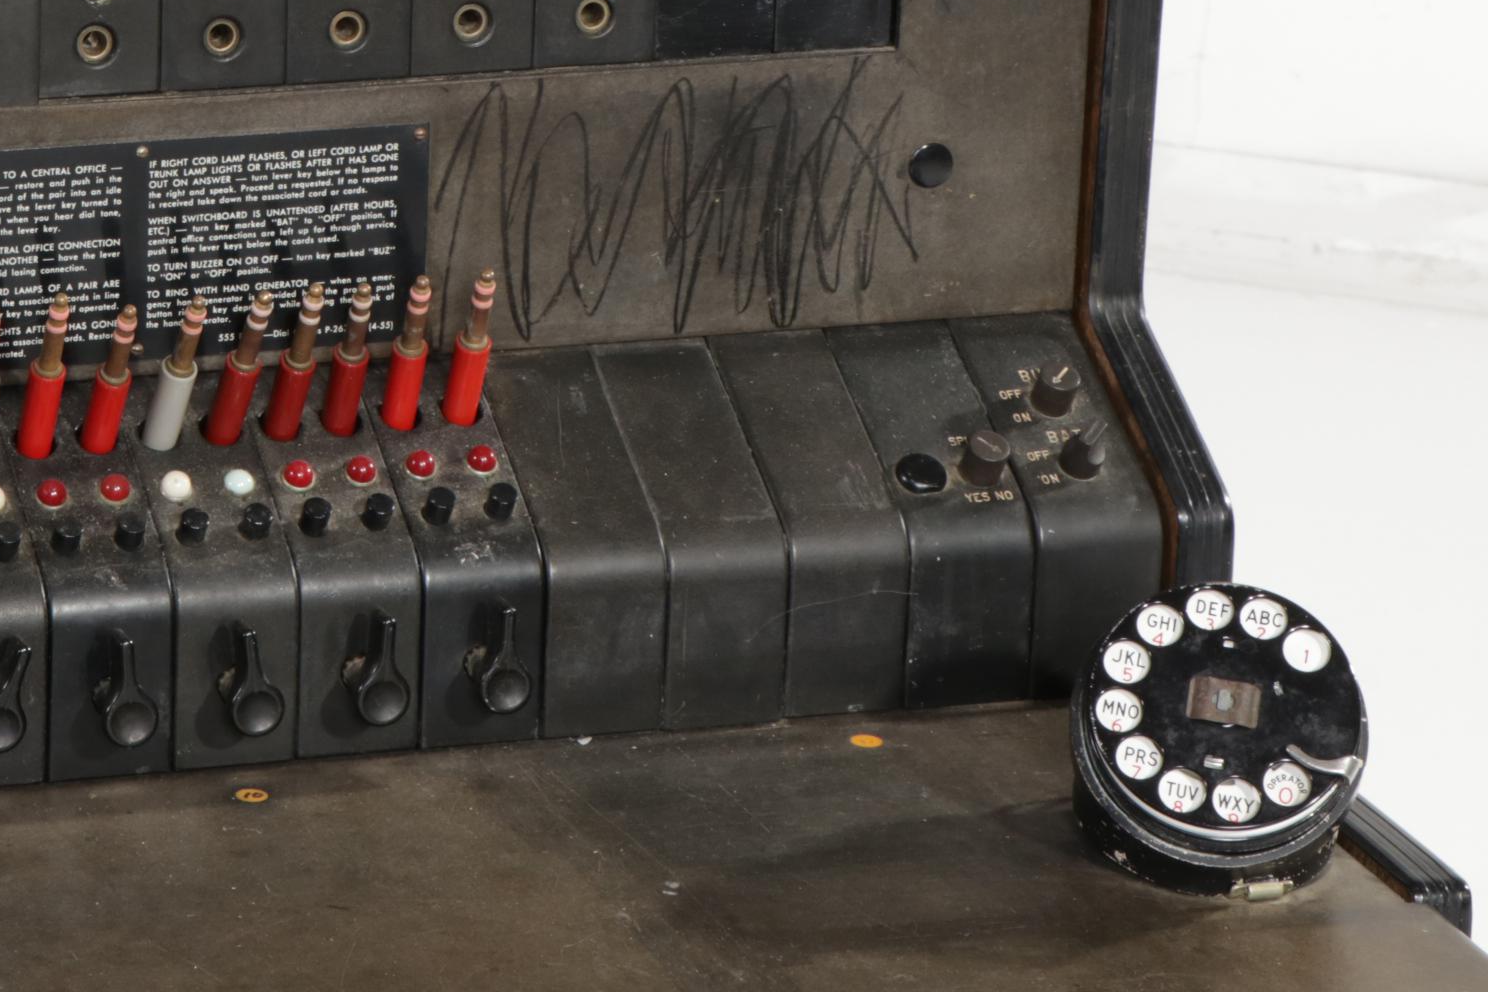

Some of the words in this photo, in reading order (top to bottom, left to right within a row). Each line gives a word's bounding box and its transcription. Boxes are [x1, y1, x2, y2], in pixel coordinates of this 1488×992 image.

[149, 160, 157, 168] IF
[160, 157, 188, 168] RIGHT
[191, 156, 218, 166] CORD
[221, 154, 245, 163] LAMP
[248, 151, 287, 161] FLASHES,
[290, 149, 304, 158] OR
[308, 147, 327, 157] LEFT
[330, 146, 356, 156] CORD
[359, 144, 382, 153] LAMP
[385, 142, 398, 151] OR
[2, 170, 16, 179] TO
[20, 170, 27, 178] A
[31, 167, 70, 177] CENTRAL
[74, 163, 106, 174] OFFICE
[147, 216, 176, 224] WHEN
[181, 210, 247, 223] SWITCHBOARD
[252, 209, 261, 218] IS
[266, 204, 325, 217] UNATTENDED
[330, 202, 358, 213] (AFTER
[363, 199, 396, 209] HOURS,
[22, 242, 54, 253] OFFICE
[57, 238, 120, 250] CONNECTION
[147, 263, 160, 272] TO
[163, 261, 187, 271] TURN
[190, 258, 223, 269] BUZZER
[226, 257, 242, 266] ON
[244, 256, 258, 265] OR
[260, 254, 278, 264] OFF
[14, 284, 43, 295] LAMPS
[47, 283, 60, 292] OF
[66, 283, 72, 291] A
[77, 280, 97, 289] PAIR
[102, 279, 119, 288] ARE
[998, 389, 1023, 400] OFF
[1013, 412, 1032, 423] ON
[1026, 449, 1049, 461] OFF
[1041, 473, 1061, 485] ON
[964, 492, 991, 503] YES
[995, 491, 1014, 501] NO
[1195, 599, 1230, 619] DEF
[1147, 613, 1177, 633] GHI
[1245, 609, 1283, 628] ABC
[1152, 633, 1164, 646] 4
[1256, 627, 1267, 639] 2
[1111, 649, 1146, 669] JKL
[1304, 649, 1310, 664] 1
[1122, 667, 1133, 681] 5
[1102, 699, 1140, 719] MNO
[1112, 719, 1122, 732] 6
[1124, 746, 1159, 768] PRS
[1132, 766, 1142, 779] 7
[1167, 781, 1199, 800] TUV
[1266, 773, 1308, 795] OPERATOR
[1173, 800, 1183, 812] 8
[1217, 796, 1256, 813] WXY
